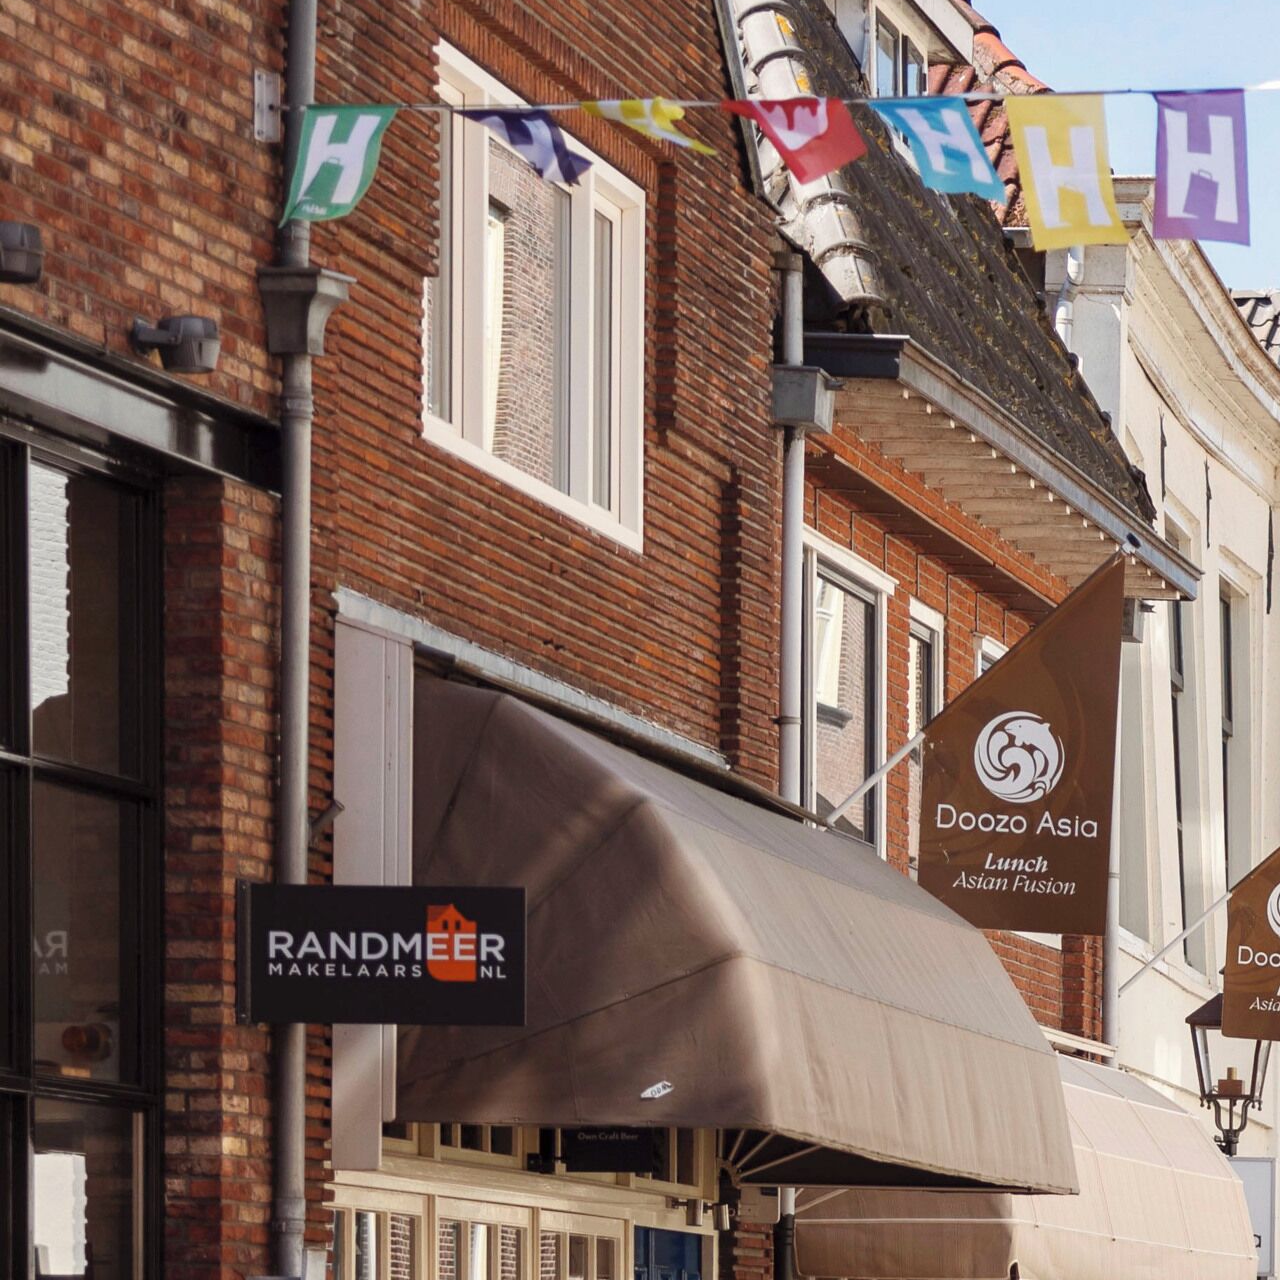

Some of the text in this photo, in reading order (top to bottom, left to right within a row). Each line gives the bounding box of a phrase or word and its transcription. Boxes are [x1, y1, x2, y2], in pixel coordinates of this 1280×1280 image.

[299, 114, 382, 204] H
[896, 108, 993, 185] H
[1024, 125, 1113, 228] H
[1165, 108, 1239, 223] H
[936, 803, 1098, 838] Doozo Asia
[984, 852, 1049, 873] Lunch
[952, 871, 1076, 895] Asian Fusion
[268, 930, 505, 962] RANDMEER
[268, 963, 507, 979] MAKELAARS NL
